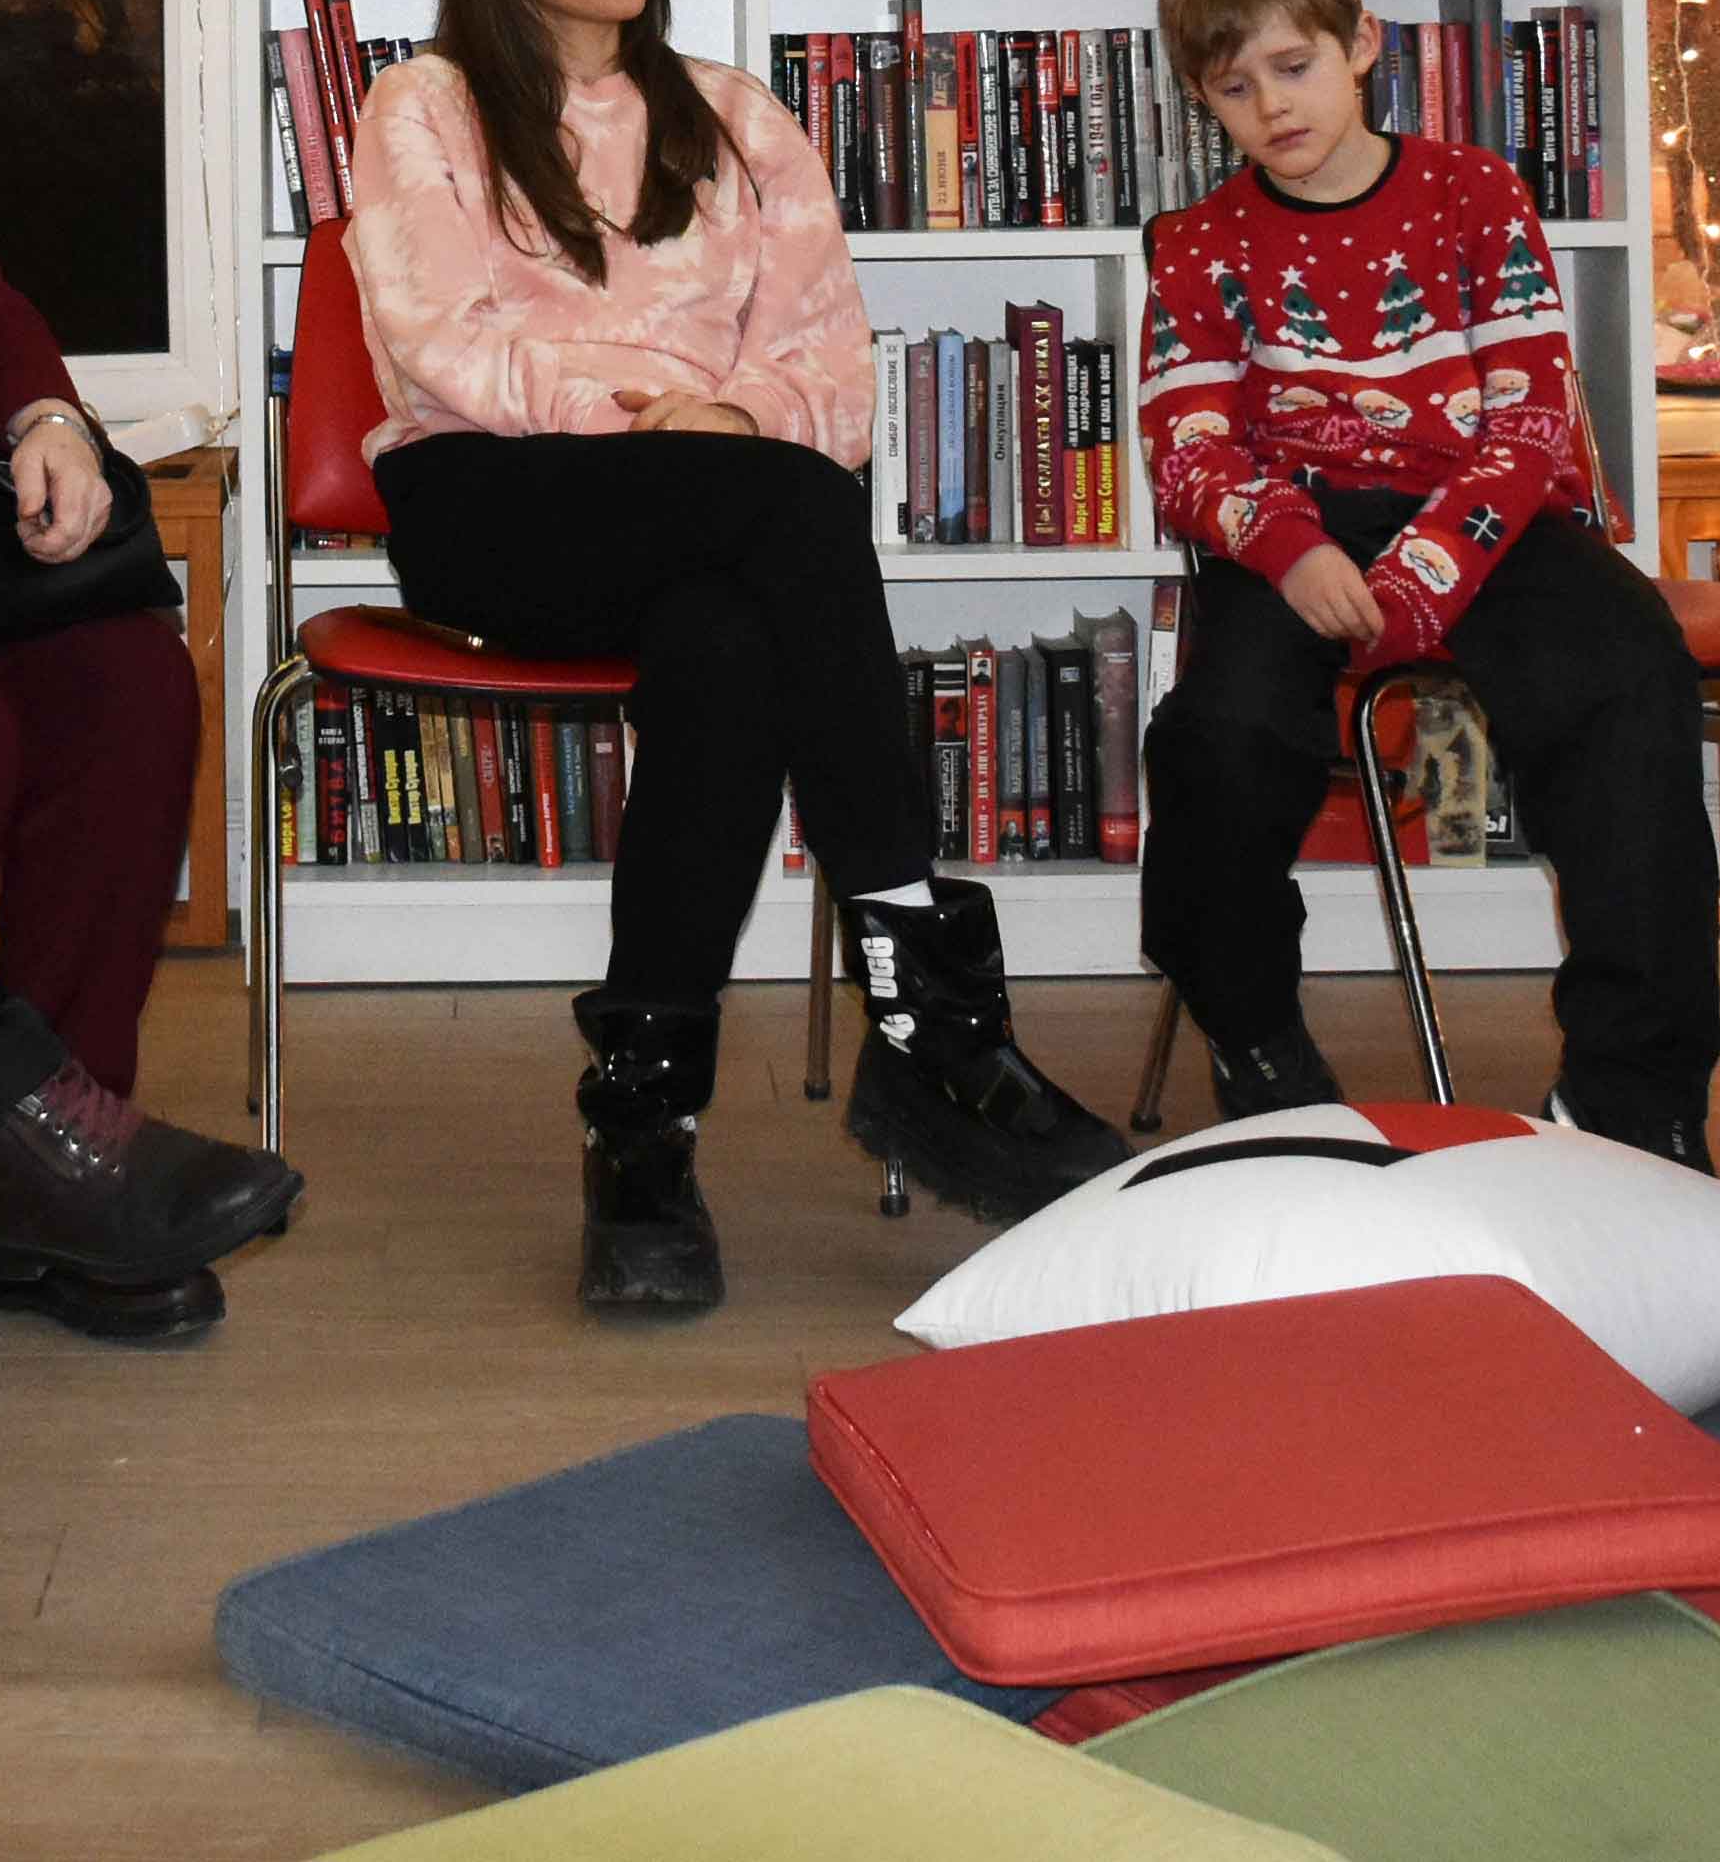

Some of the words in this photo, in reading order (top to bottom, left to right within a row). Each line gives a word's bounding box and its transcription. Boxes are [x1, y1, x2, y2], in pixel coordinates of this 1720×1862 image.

[1568, 23, 1579, 62] РОДИНУ
[1512, 57, 1525, 96] ПРАВДА
[1569, 63, 1578, 76] ЗА
[982, 73, 997, 111] ВЫСОТЫ
[1088, 83, 1106, 109] год
[1569, 78, 1580, 136] СРАЖАЛИСЬ
[1088, 114, 1104, 149] 1941
[1513, 97, 1526, 149] СТРАШНАЯ
[986, 113, 1000, 178] СИНЯВИНСКИЕ
[1570, 137, 1580, 156] ОНИ
[988, 178, 1000, 190] ЗА
[989, 191, 1001, 222] БИТВА
[886, 359, 898, 415] ПОСЛЕСЛОВИЕ
[1066, 354, 1077, 393] СПЯЩИХ
[1099, 354, 1111, 381] ВОЙНЕ
[1078, 364, 1090, 431] АЭРОДРОМАХ»
[1100, 384, 1111, 395] НА
[994, 384, 1007, 461] Оккупация
[1067, 394, 1077, 430] МИРНО
[1100, 397, 1111, 423] БЛАГА
[887, 421, 898, 458] СОБИБОР
[1100, 427, 1111, 441] НЕТ
[1036, 417, 1051, 498] СОЛДАТЫ
[1071, 451, 1086, 500] Солонин
[1097, 444, 1113, 497] Солонин
[1072, 502, 1087, 536] Марк
[1098, 498, 1114, 535] Марк
[975, 694, 988, 746] ГЕНЕРАЛА
[328, 761, 346, 843] БИТВА
[941, 748, 953, 833] ГЕНЕРАЛ
[976, 779, 989, 800] ДВА
[976, 813, 989, 854] ВЛАСОВ
[861, 936, 900, 999] UGG
